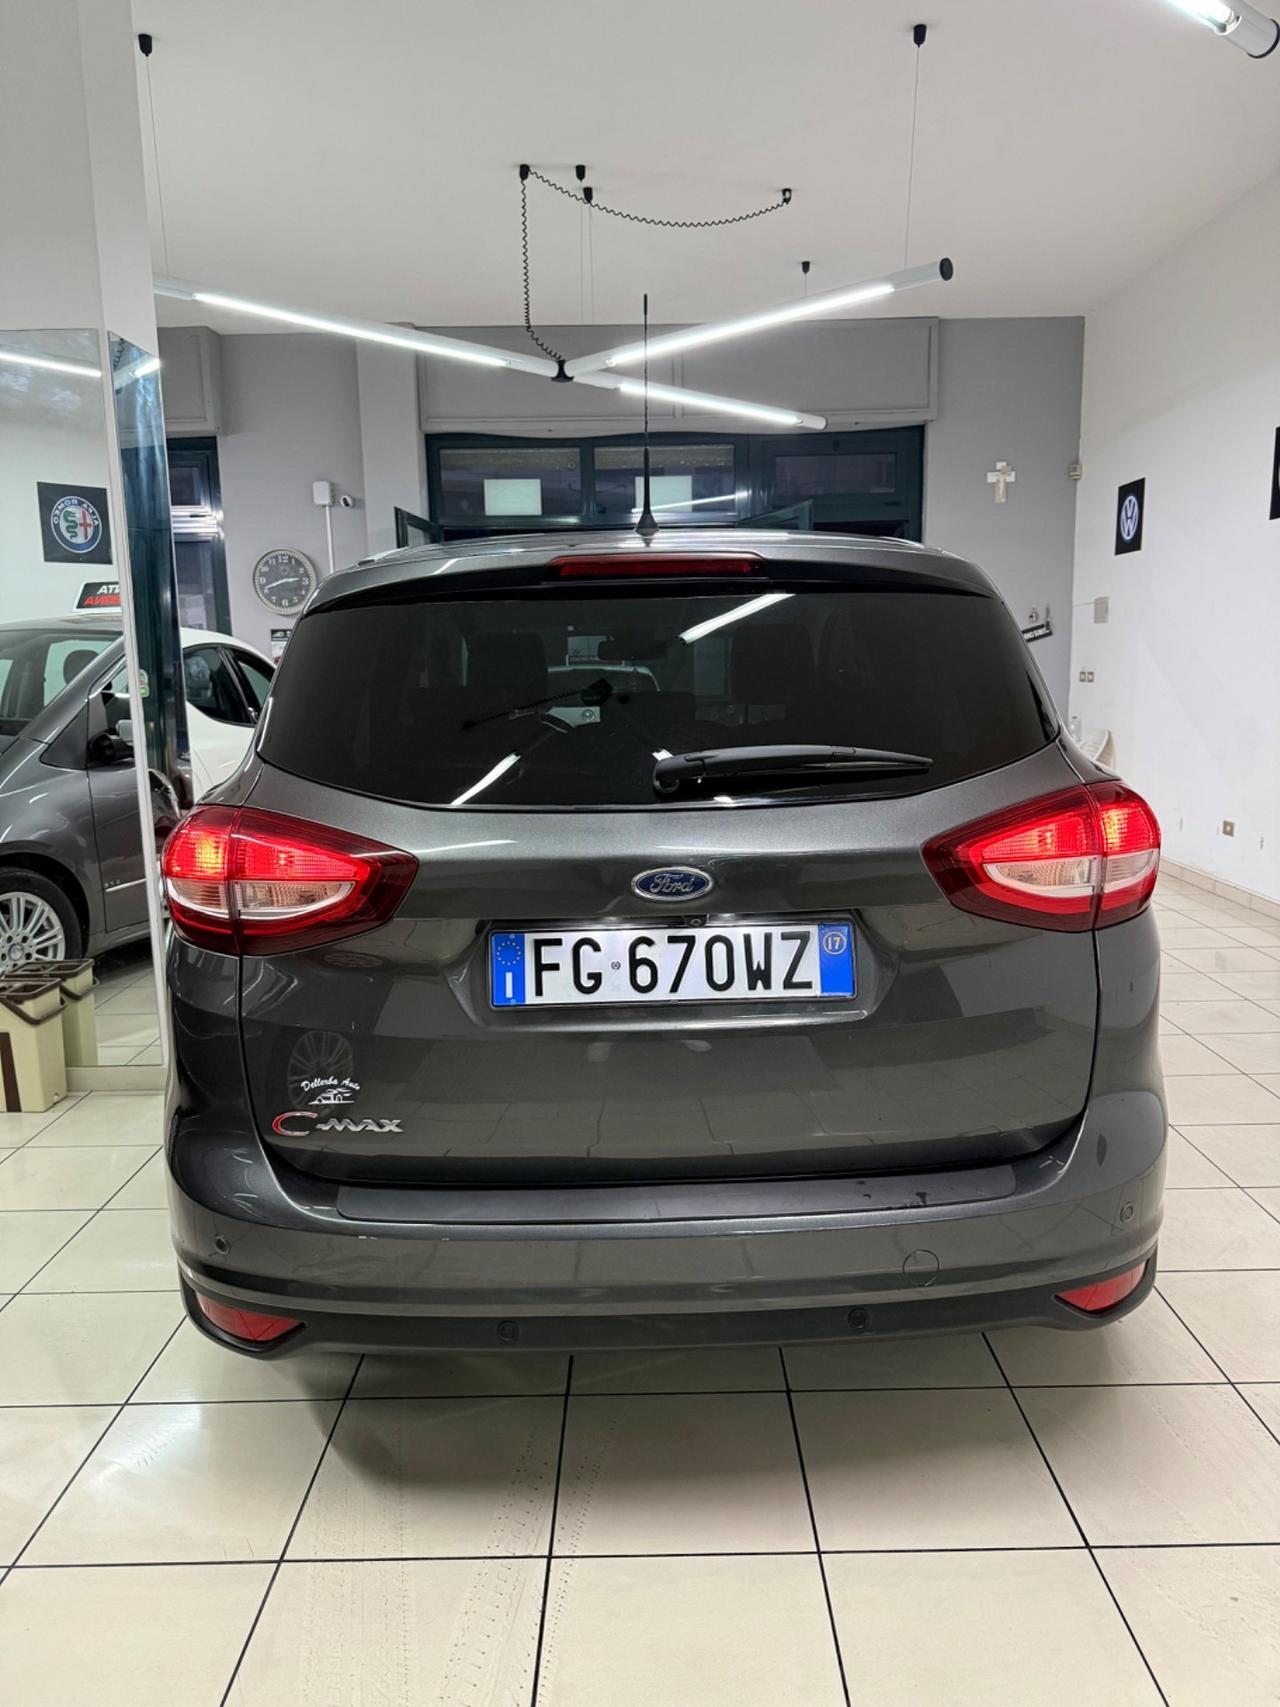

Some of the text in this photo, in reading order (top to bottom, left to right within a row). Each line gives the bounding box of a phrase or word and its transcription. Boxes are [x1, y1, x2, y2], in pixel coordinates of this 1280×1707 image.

[278, 555, 289, 563] 12
[649, 873, 696, 893] Ford
[829, 936, 841, 950] 17
[533, 931, 813, 997] FG 670WZ
[301, 1076, 361, 1091] Dellerba Auto
[272, 1111, 404, 1136] C-MAX
